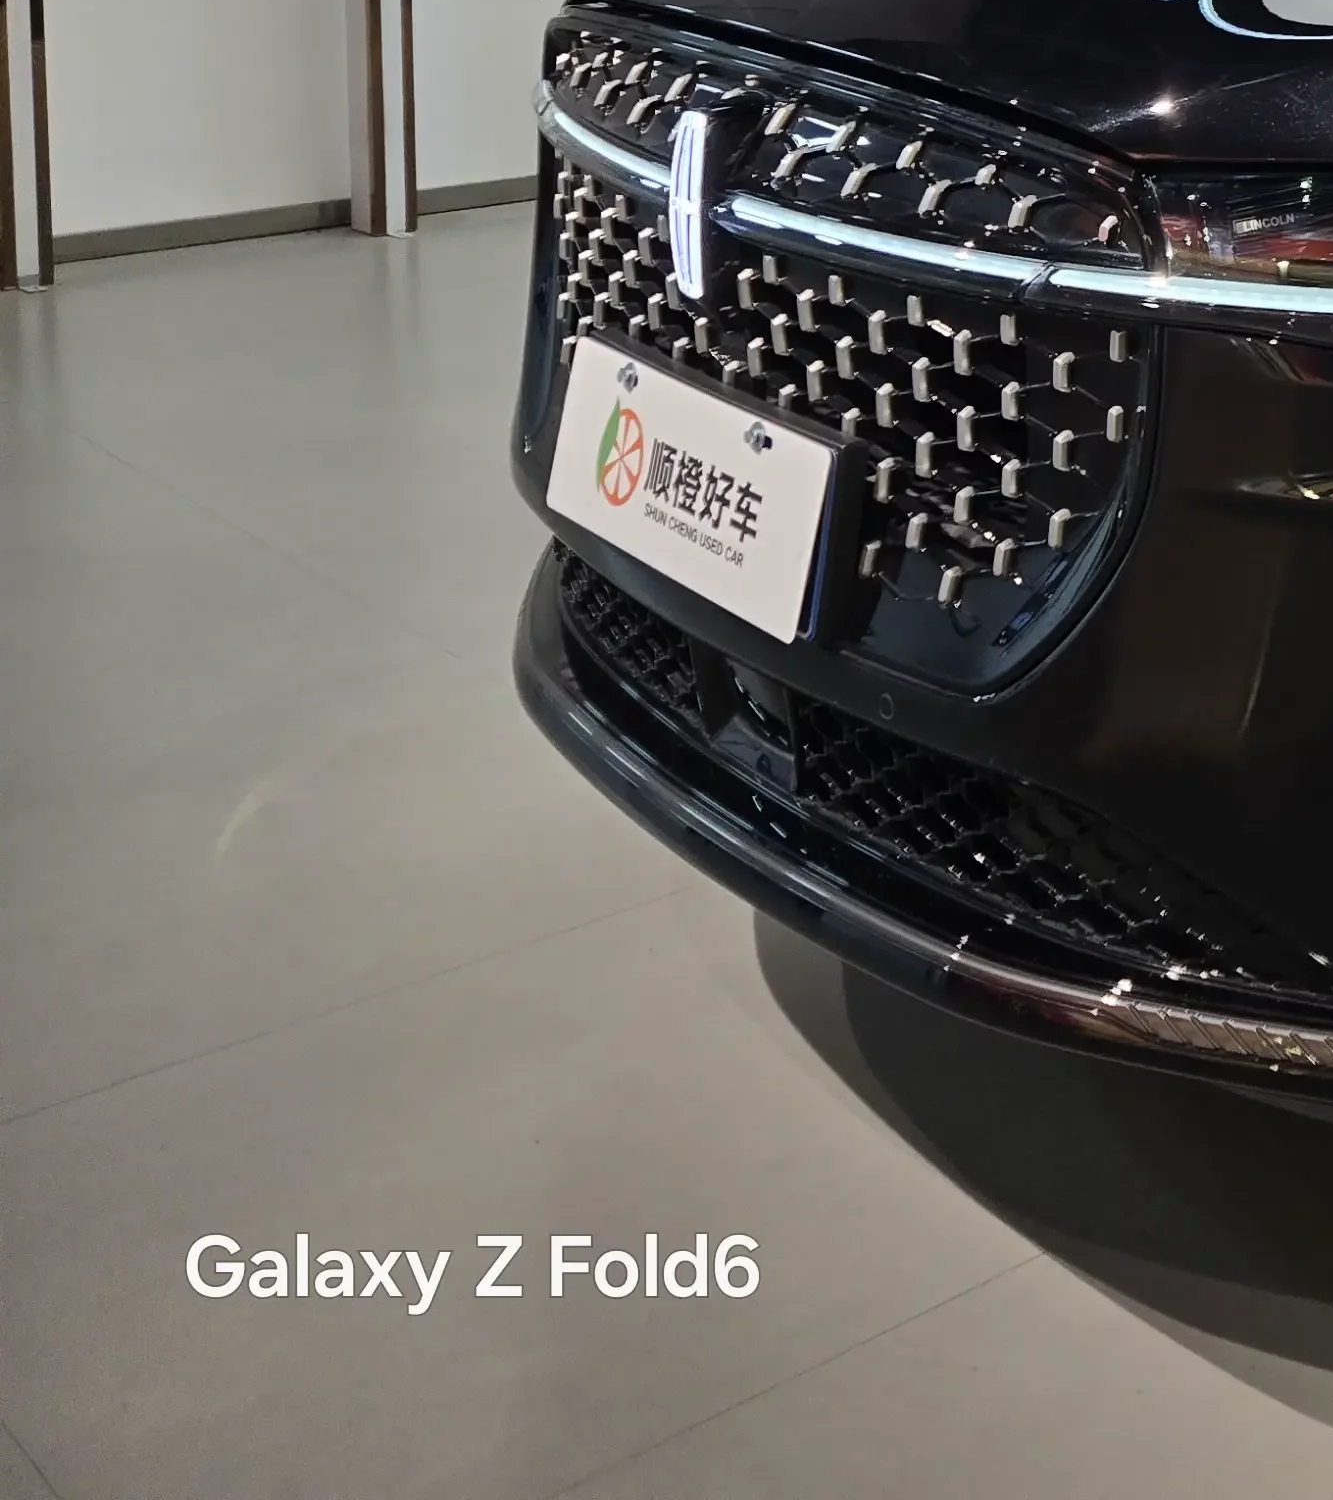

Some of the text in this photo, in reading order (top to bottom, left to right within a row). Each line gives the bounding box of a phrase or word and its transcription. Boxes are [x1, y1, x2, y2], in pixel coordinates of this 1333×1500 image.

[1243, 213, 1295, 231] LINCOLN
[643, 438, 763, 543] 顺橙好车
[643, 502, 745, 568] SHUN CHENG USED CAR
